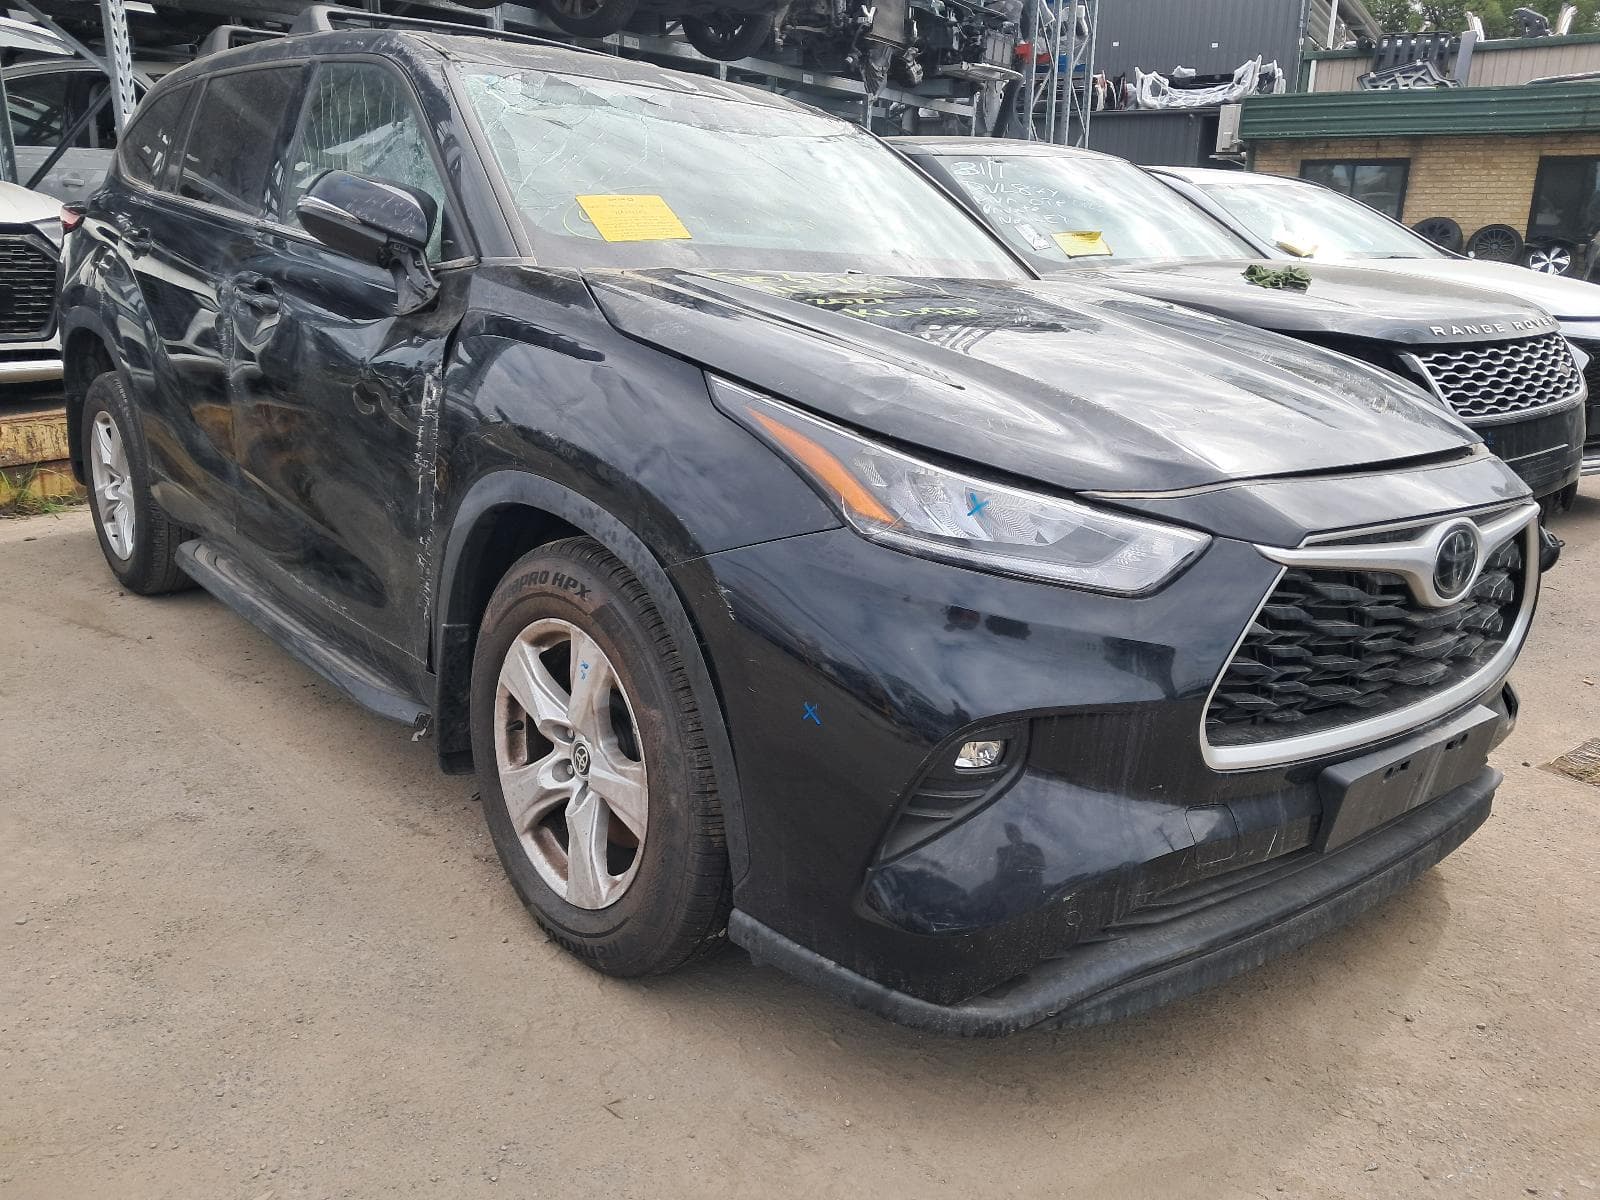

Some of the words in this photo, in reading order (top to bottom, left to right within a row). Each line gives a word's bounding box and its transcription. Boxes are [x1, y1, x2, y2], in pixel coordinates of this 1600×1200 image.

[1429, 324, 1505, 336] RANGE
[1512, 316, 1554, 330] ROVER
[552, 573, 592, 601] HPX
